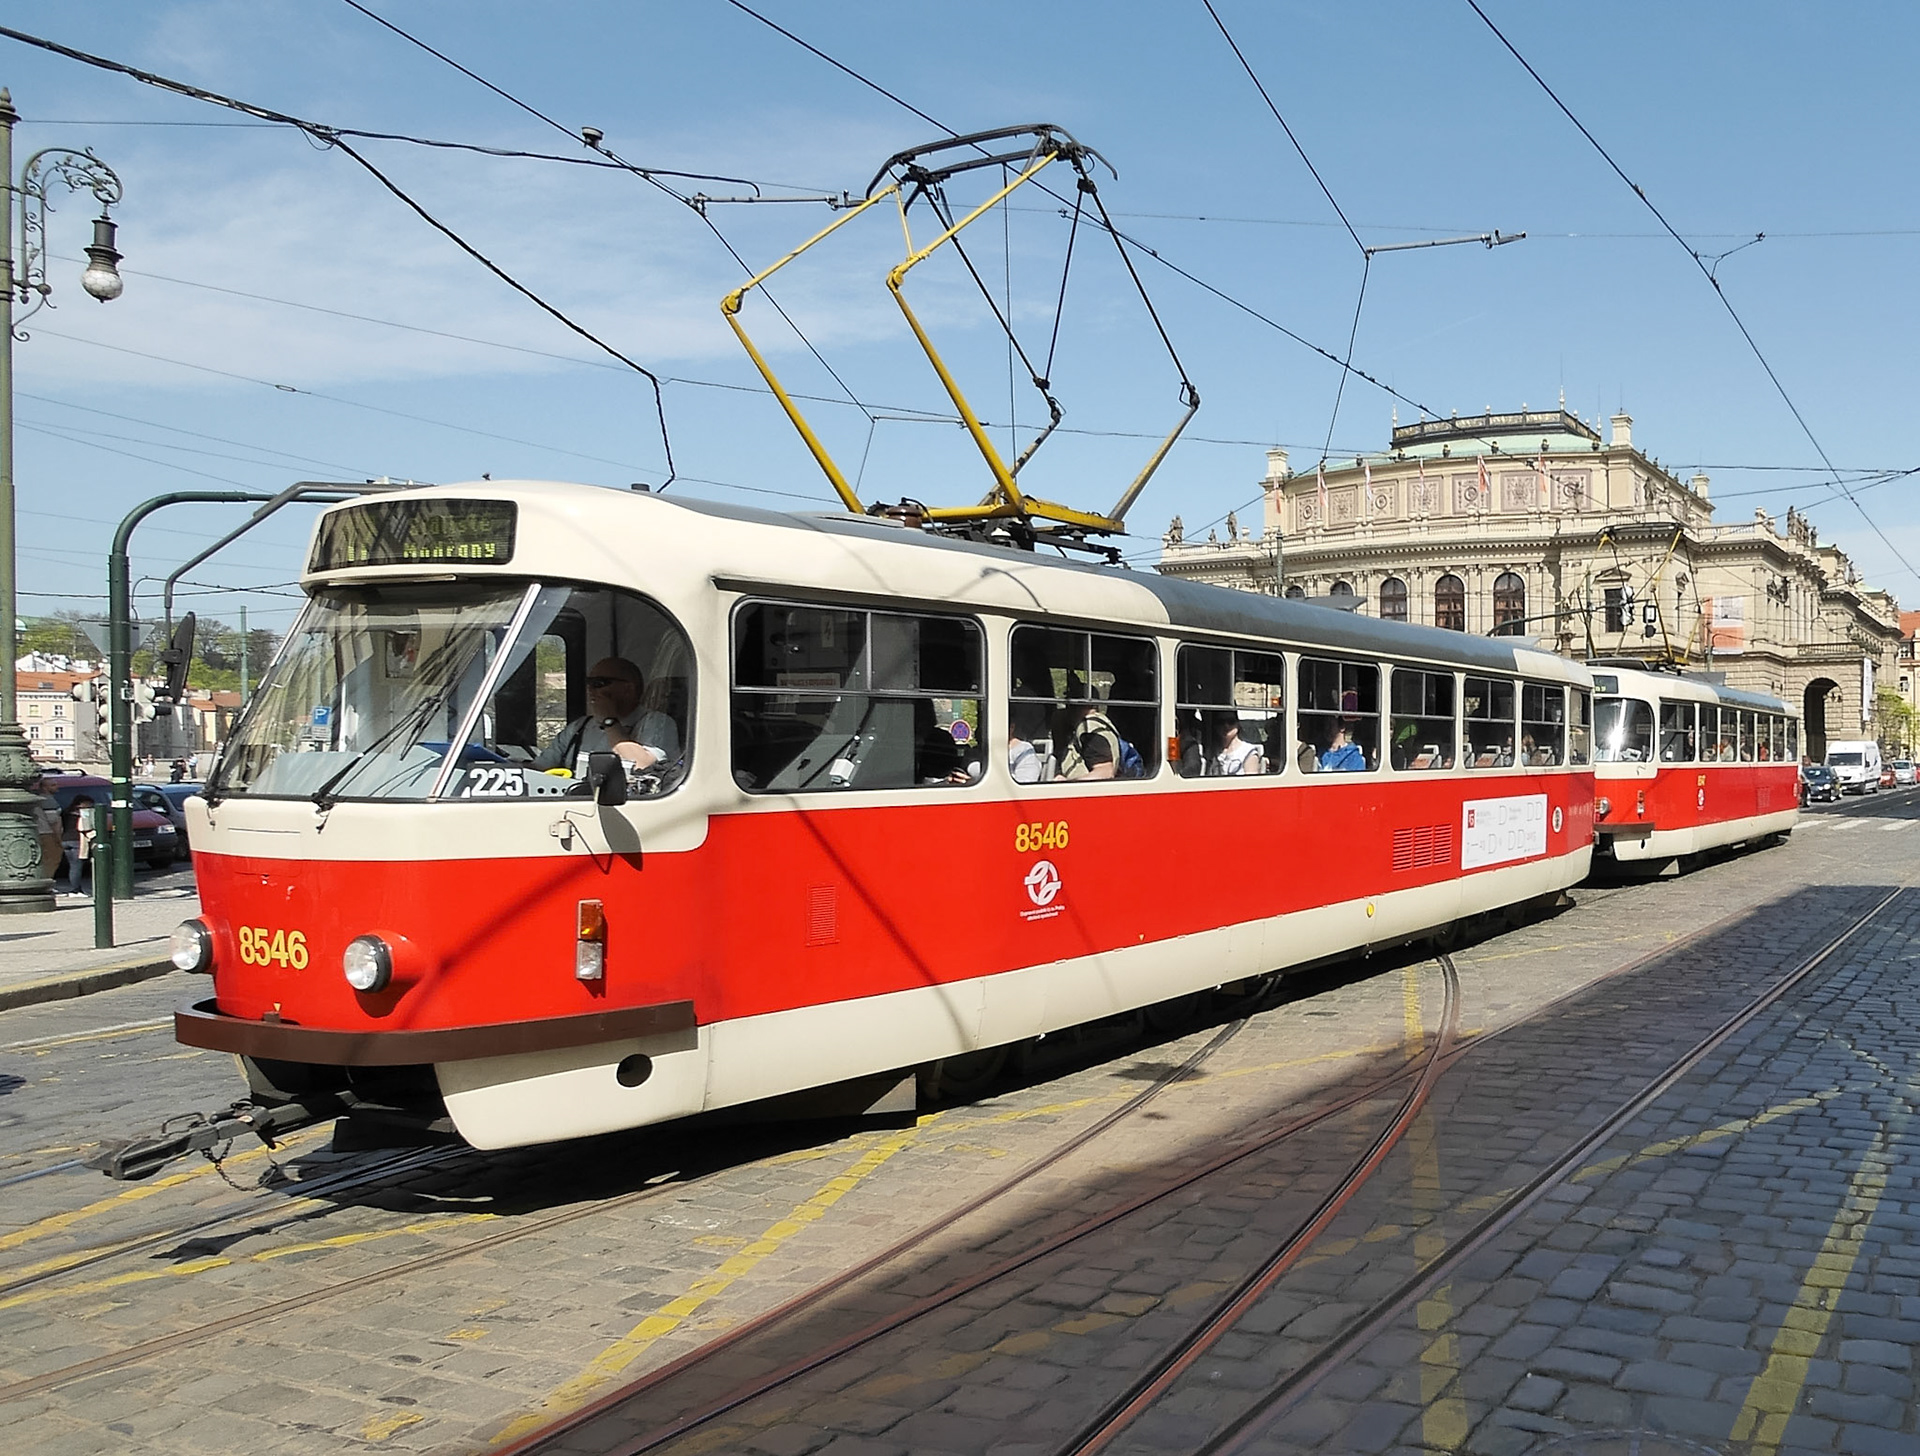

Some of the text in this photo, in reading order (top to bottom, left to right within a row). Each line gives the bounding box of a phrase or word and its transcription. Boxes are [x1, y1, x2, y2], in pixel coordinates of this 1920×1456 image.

[469, 767, 524, 797] 225
[1015, 820, 1069, 852] 8546
[238, 925, 309, 970] 8546
